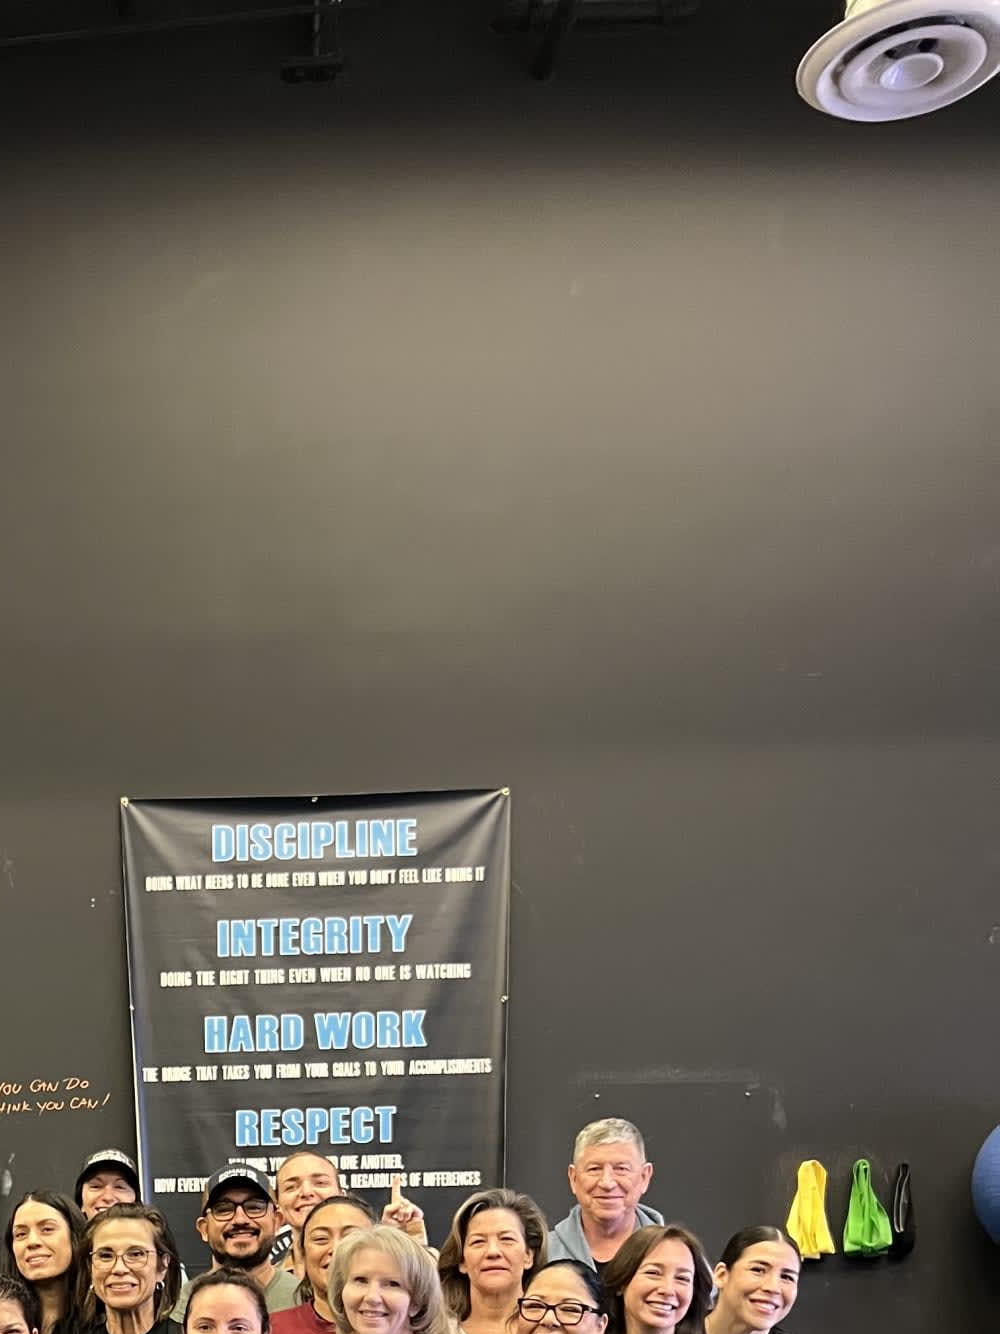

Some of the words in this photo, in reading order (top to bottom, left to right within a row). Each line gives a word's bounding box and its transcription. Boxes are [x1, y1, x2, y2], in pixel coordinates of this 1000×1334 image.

[211, 819, 417, 863] DISCIPLINE
[145, 876, 173, 892] DOING
[175, 875, 202, 891] WHAT
[205, 874, 234, 890] NEEDS
[237, 873, 249, 888] TO
[251, 873, 264, 888] BE
[266, 872, 290, 888] DONE
[292, 871, 316, 887] EVEN
[318, 870, 346, 886] WHEN
[348, 869, 367, 885] YOU
[369, 869, 396, 884] DON'T
[399, 868, 419, 883] FEEL
[422, 867, 443, 883] LIKE
[445, 867, 473, 882] DOING
[475, 866, 486, 881] IT
[217, 914, 413, 958] INTEGRITY
[160, 970, 192, 987] DOING
[196, 970, 216, 985] THE
[220, 969, 250, 985] RIGHT
[254, 968, 285, 984] THING
[289, 967, 316, 984] EVEN
[320, 967, 352, 982] WHEN
[355, 966, 371, 981] NO
[374, 965, 396, 981] ONE
[400, 965, 412, 980] IS
[415, 963, 472, 979] WATCHING
[204, 1014, 303, 1054] HARD
[314, 1009, 428, 1050] WORK
[142, 1067, 159, 1082] THE
[195, 1065, 218, 1081] THAT
[222, 1065, 250, 1080] TAKES
[254, 1064, 273, 1079] YOU
[276, 1063, 301, 1079] FROM
[304, 1063, 329, 1078] YOUR
[332, 1062, 361, 1077] GOALS
[364, 1062, 377, 1076] TO
[380, 1060, 405, 1076] YOUR
[408, 1058, 492, 1075] ACCOMPLISHMENTS
[30, 1079, 59, 1093] CAN
[63, 1077, 89, 1091] DO
[36, 1101, 65, 1116] YOU
[235, 1105, 397, 1147] RESPECT
[340, 1156, 359, 1170] ONE
[351, 1173, 407, 1188] REGARDLS
[409, 1172, 421, 1187] OF
[423, 1171, 481, 1186] DIFFERENCES
